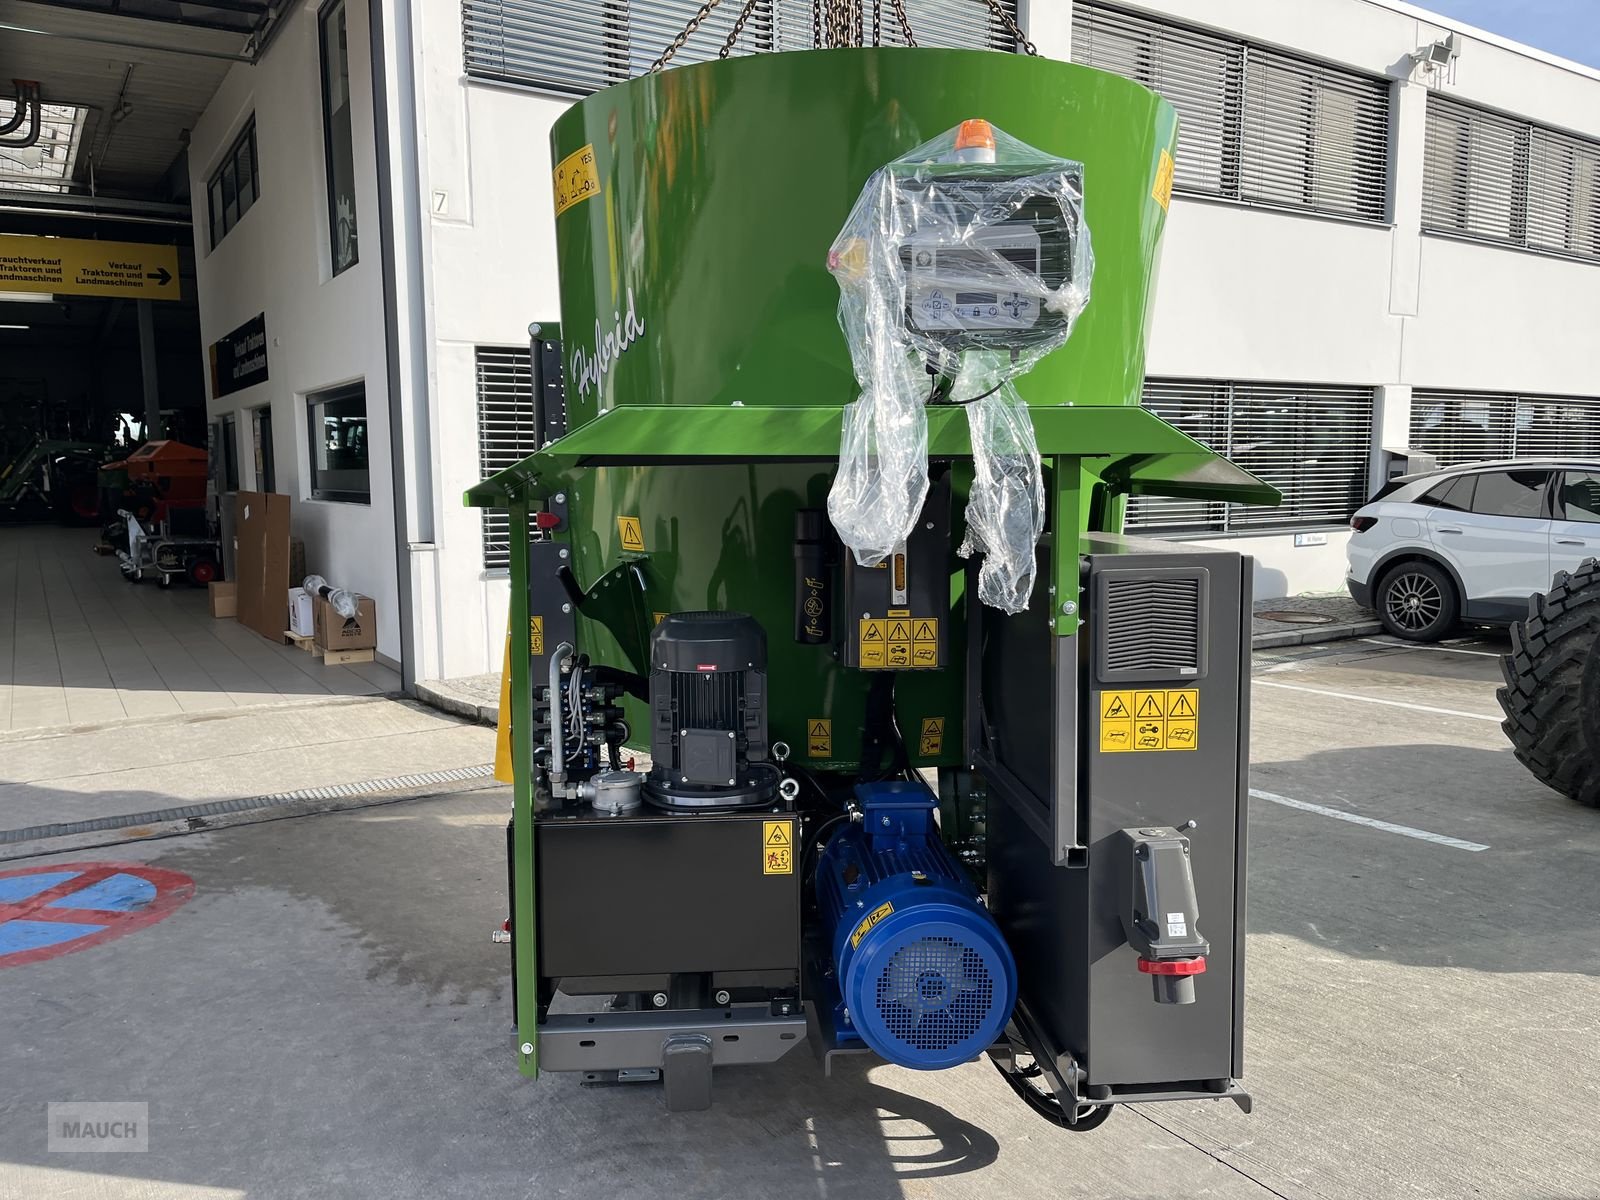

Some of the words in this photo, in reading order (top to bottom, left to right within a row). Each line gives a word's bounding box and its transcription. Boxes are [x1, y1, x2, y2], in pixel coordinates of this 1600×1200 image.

[580, 152, 593, 165] YES
[435, 191, 446, 211] 7
[0, 264, 43, 273] Traktoren
[108, 261, 142, 271] Verkauf
[81, 268, 124, 278] Traktoren
[75, 276, 144, 287] Landmaschinen
[569, 287, 645, 404] Hybrid
